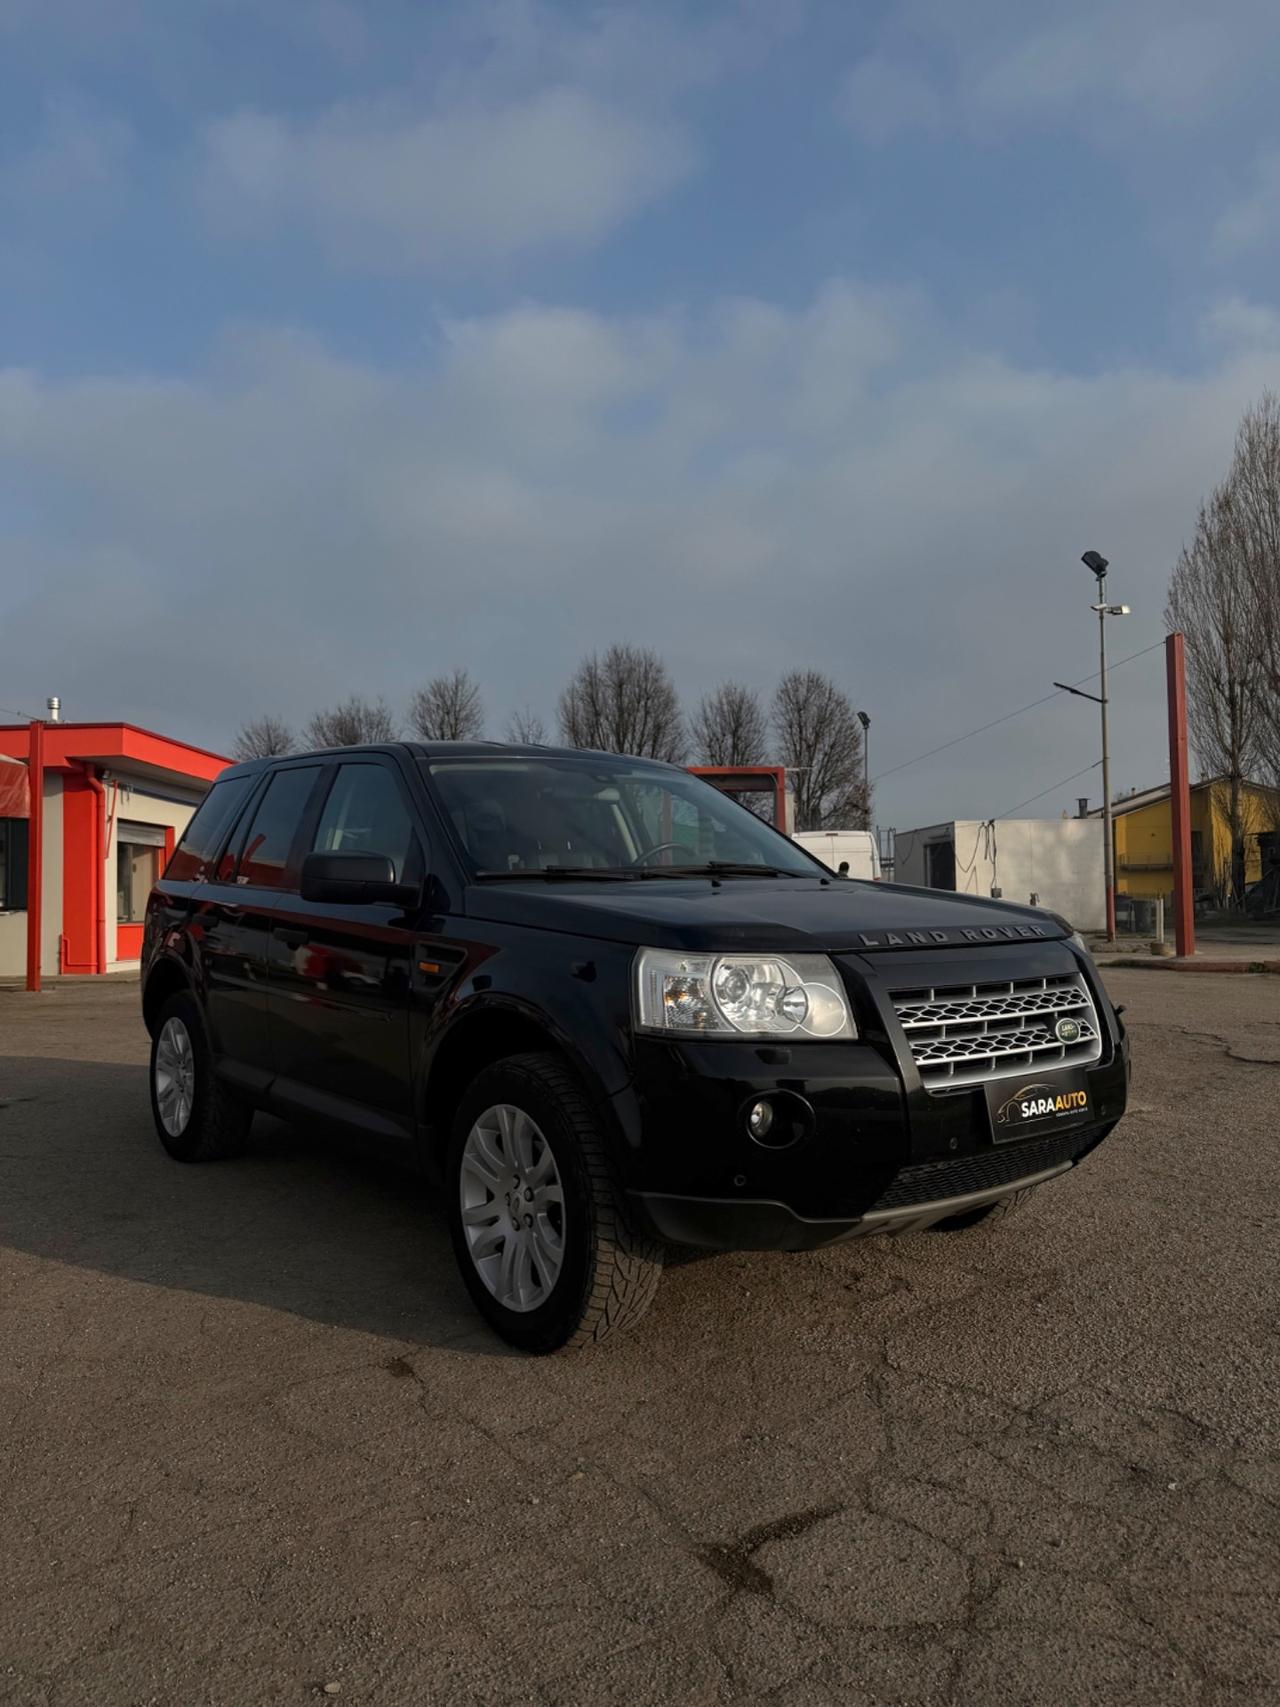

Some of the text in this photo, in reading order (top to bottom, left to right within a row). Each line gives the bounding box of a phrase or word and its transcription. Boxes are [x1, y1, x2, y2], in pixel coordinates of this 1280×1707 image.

[859, 924, 1047, 946] LAND ROVER
[1021, 1091, 1087, 1118] SARAAUTO
